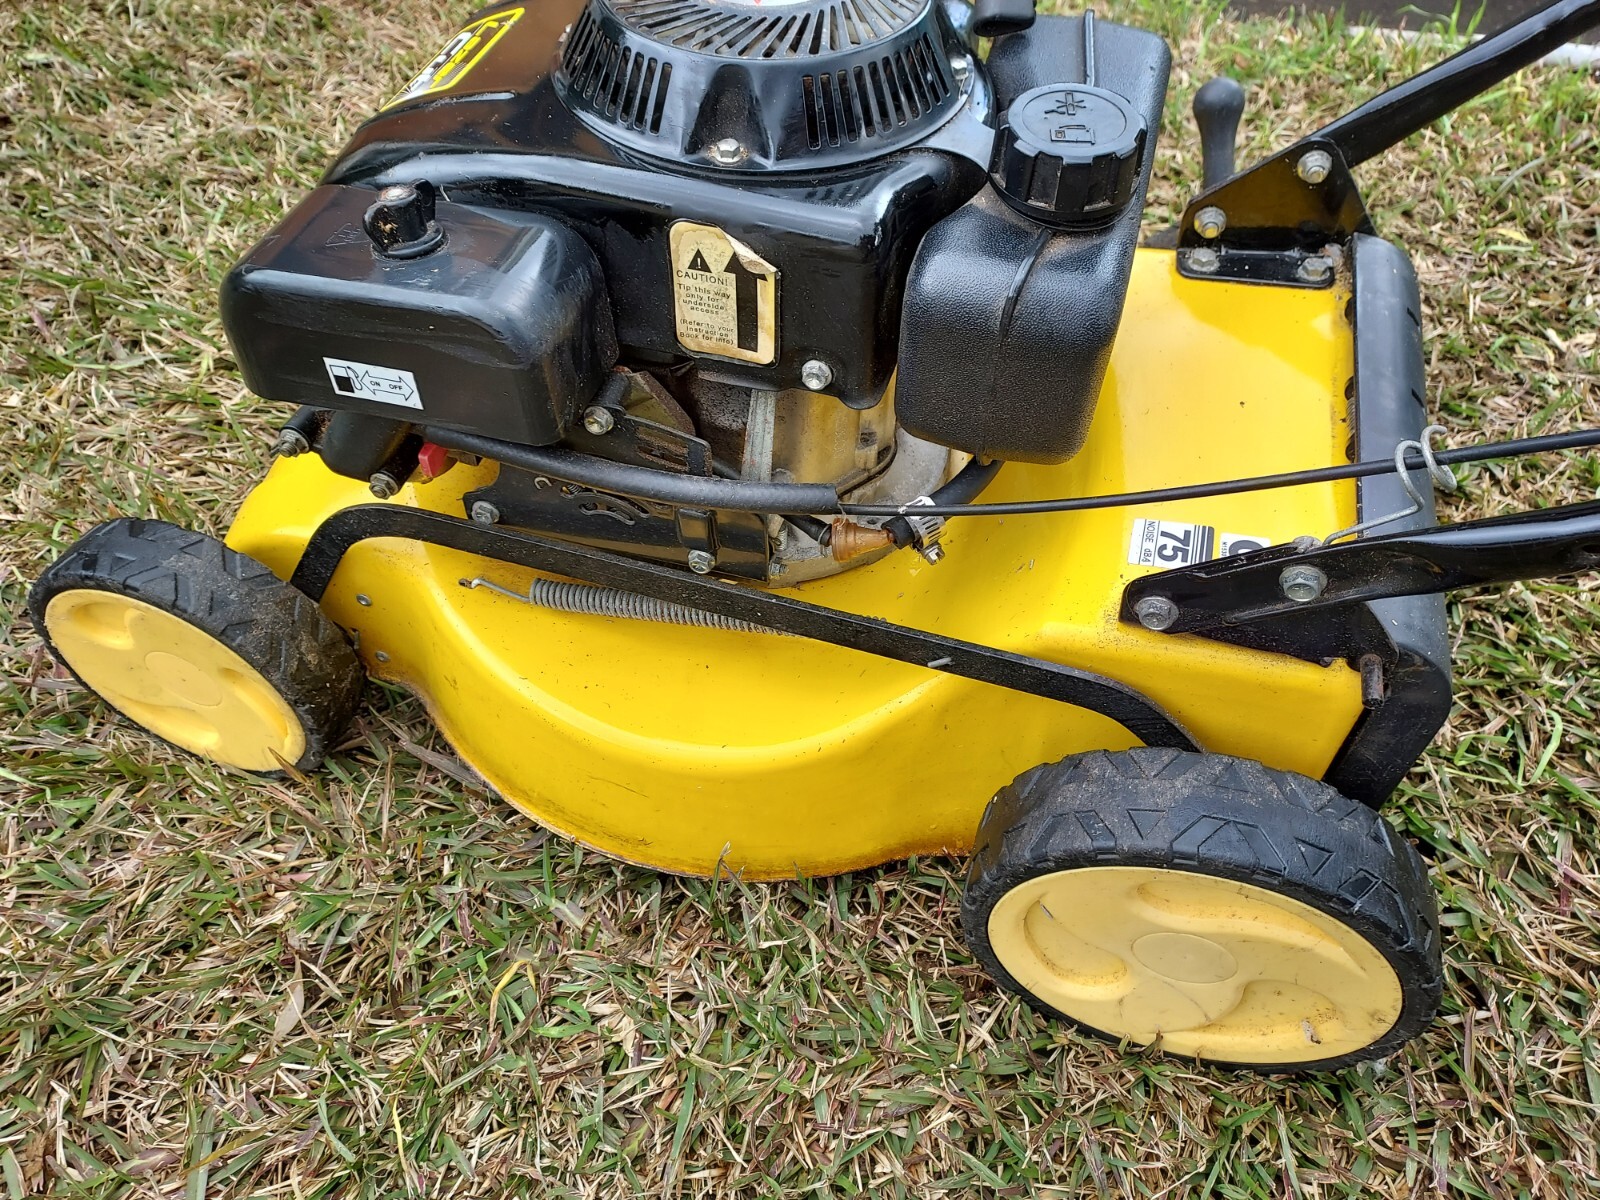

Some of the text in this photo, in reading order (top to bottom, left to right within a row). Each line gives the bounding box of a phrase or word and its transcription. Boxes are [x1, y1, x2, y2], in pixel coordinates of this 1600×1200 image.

[676, 270, 728, 286] CAUTION!
[677, 282, 731, 299] Tip this way
[685, 292, 703, 301] only
[683, 299, 725, 310] underside
[690, 306, 719, 315] access
[680, 319, 704, 327] (Refer
[679, 331, 699, 339] Book
[1145, 521, 1156, 543] NOISE
[1158, 530, 1192, 563] 75
